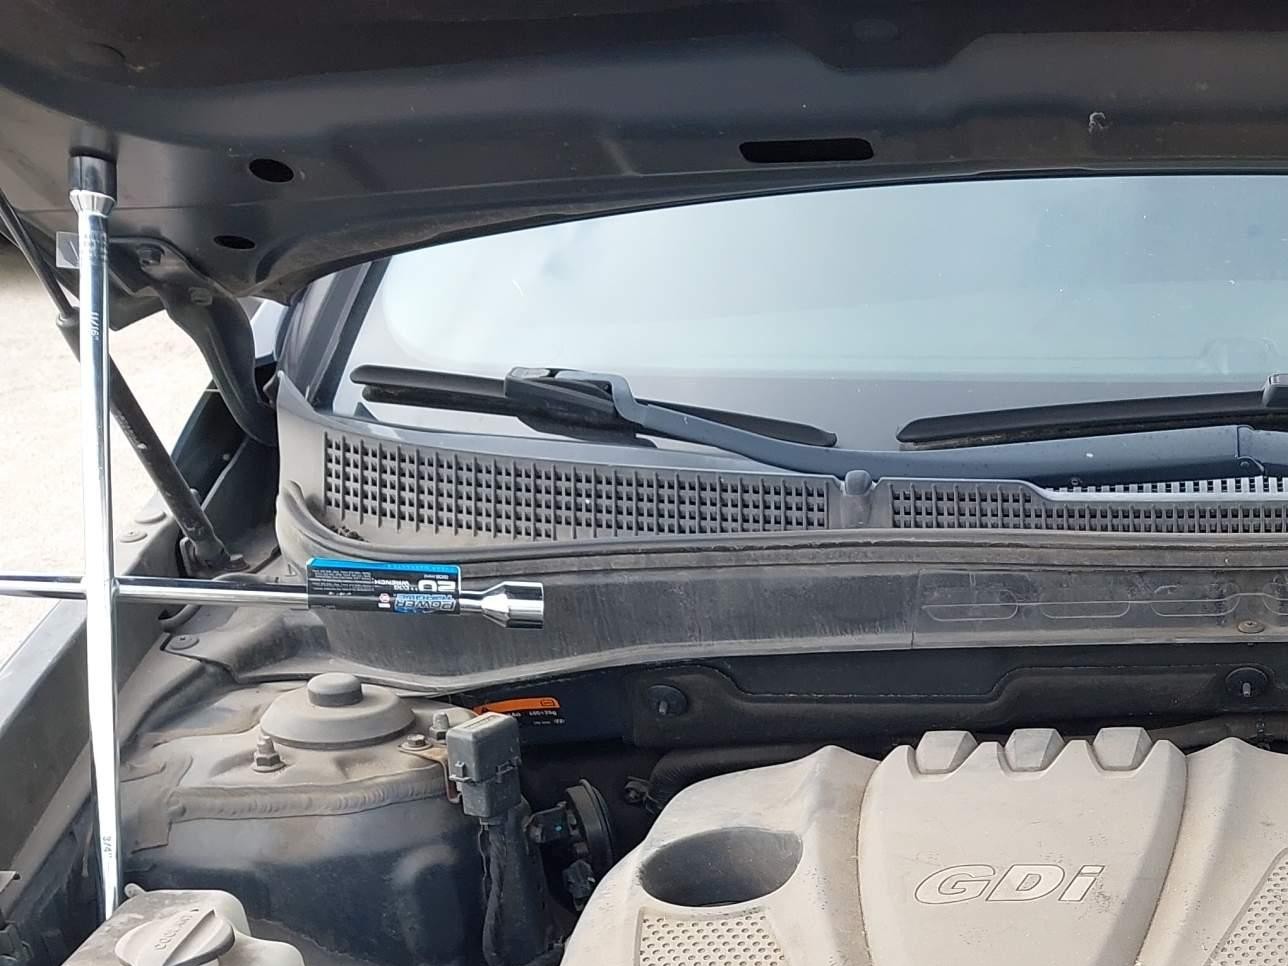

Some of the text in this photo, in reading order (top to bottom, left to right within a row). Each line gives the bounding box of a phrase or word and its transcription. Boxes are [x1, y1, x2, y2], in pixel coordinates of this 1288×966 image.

[394, 600, 457, 611] POWER
[102, 835, 113, 859] 3/4"
[912, 864, 1105, 906] GDi
